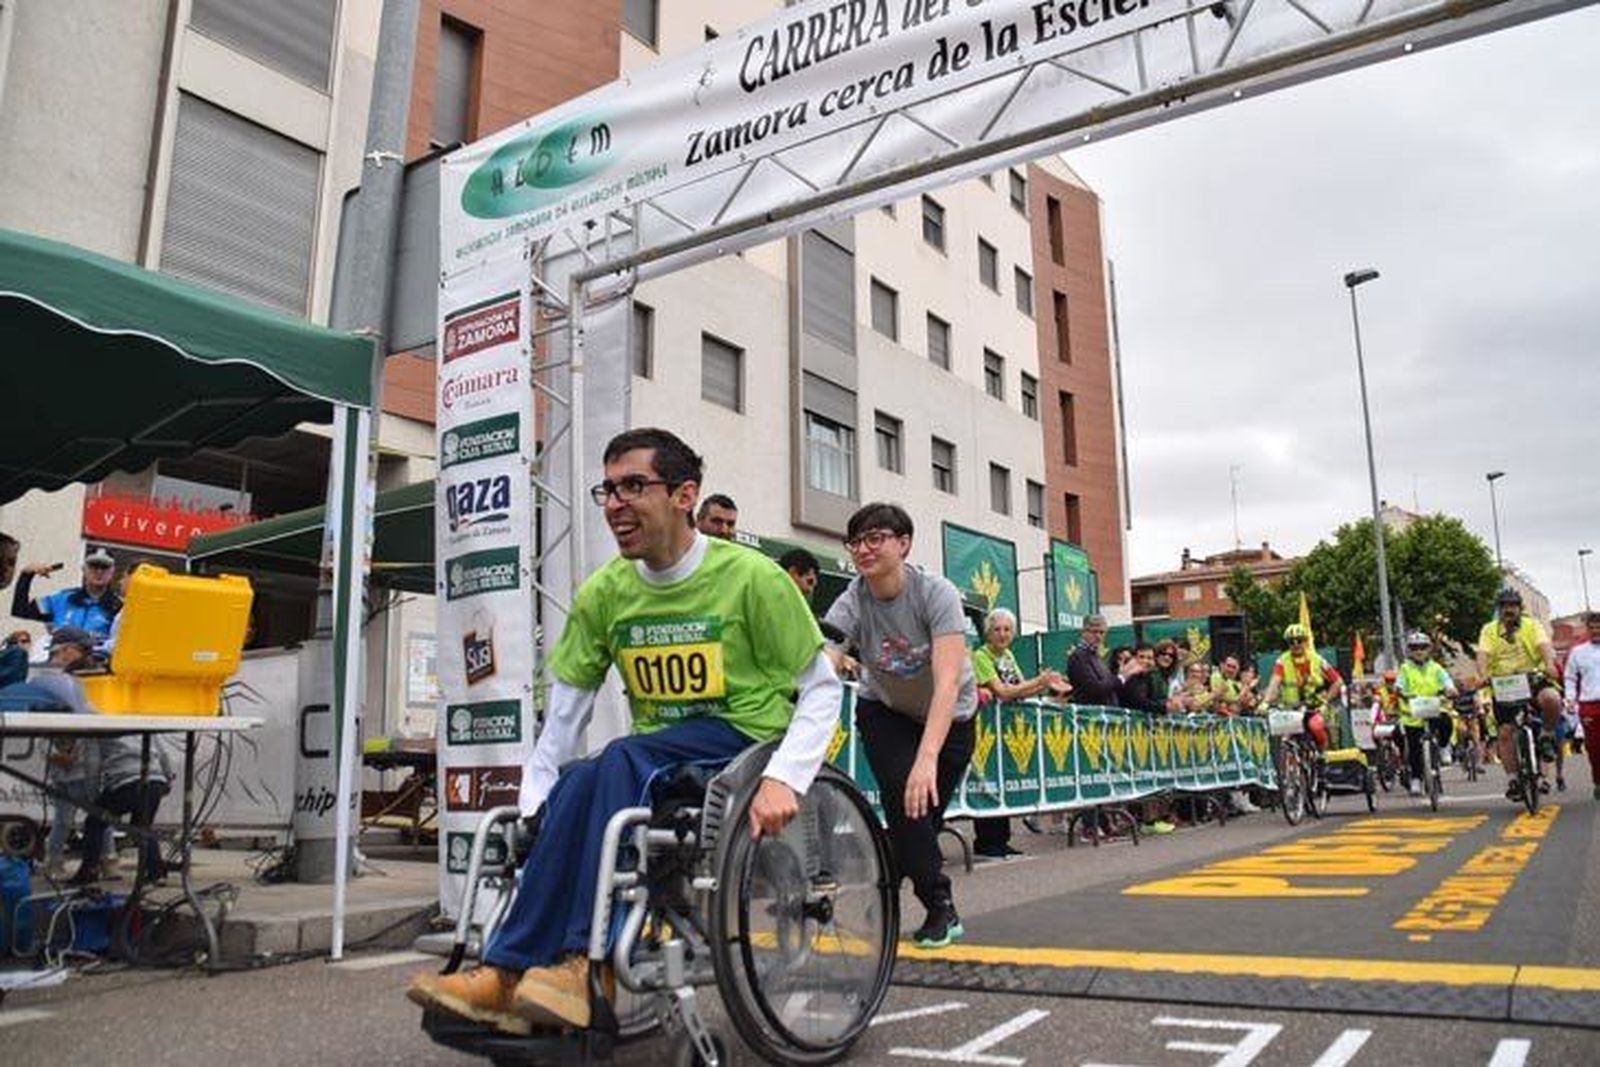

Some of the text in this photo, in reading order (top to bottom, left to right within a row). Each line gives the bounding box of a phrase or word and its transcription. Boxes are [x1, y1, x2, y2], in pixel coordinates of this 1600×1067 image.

[738, 0, 889, 93] CARRERA
[684, 100, 809, 167] Zamora
[819, 64, 915, 117] cerca
[927, 37, 970, 81] de
[981, 20, 1019, 62] la
[457, 319, 516, 349] ZAMORA
[633, 651, 708, 695] 0109
